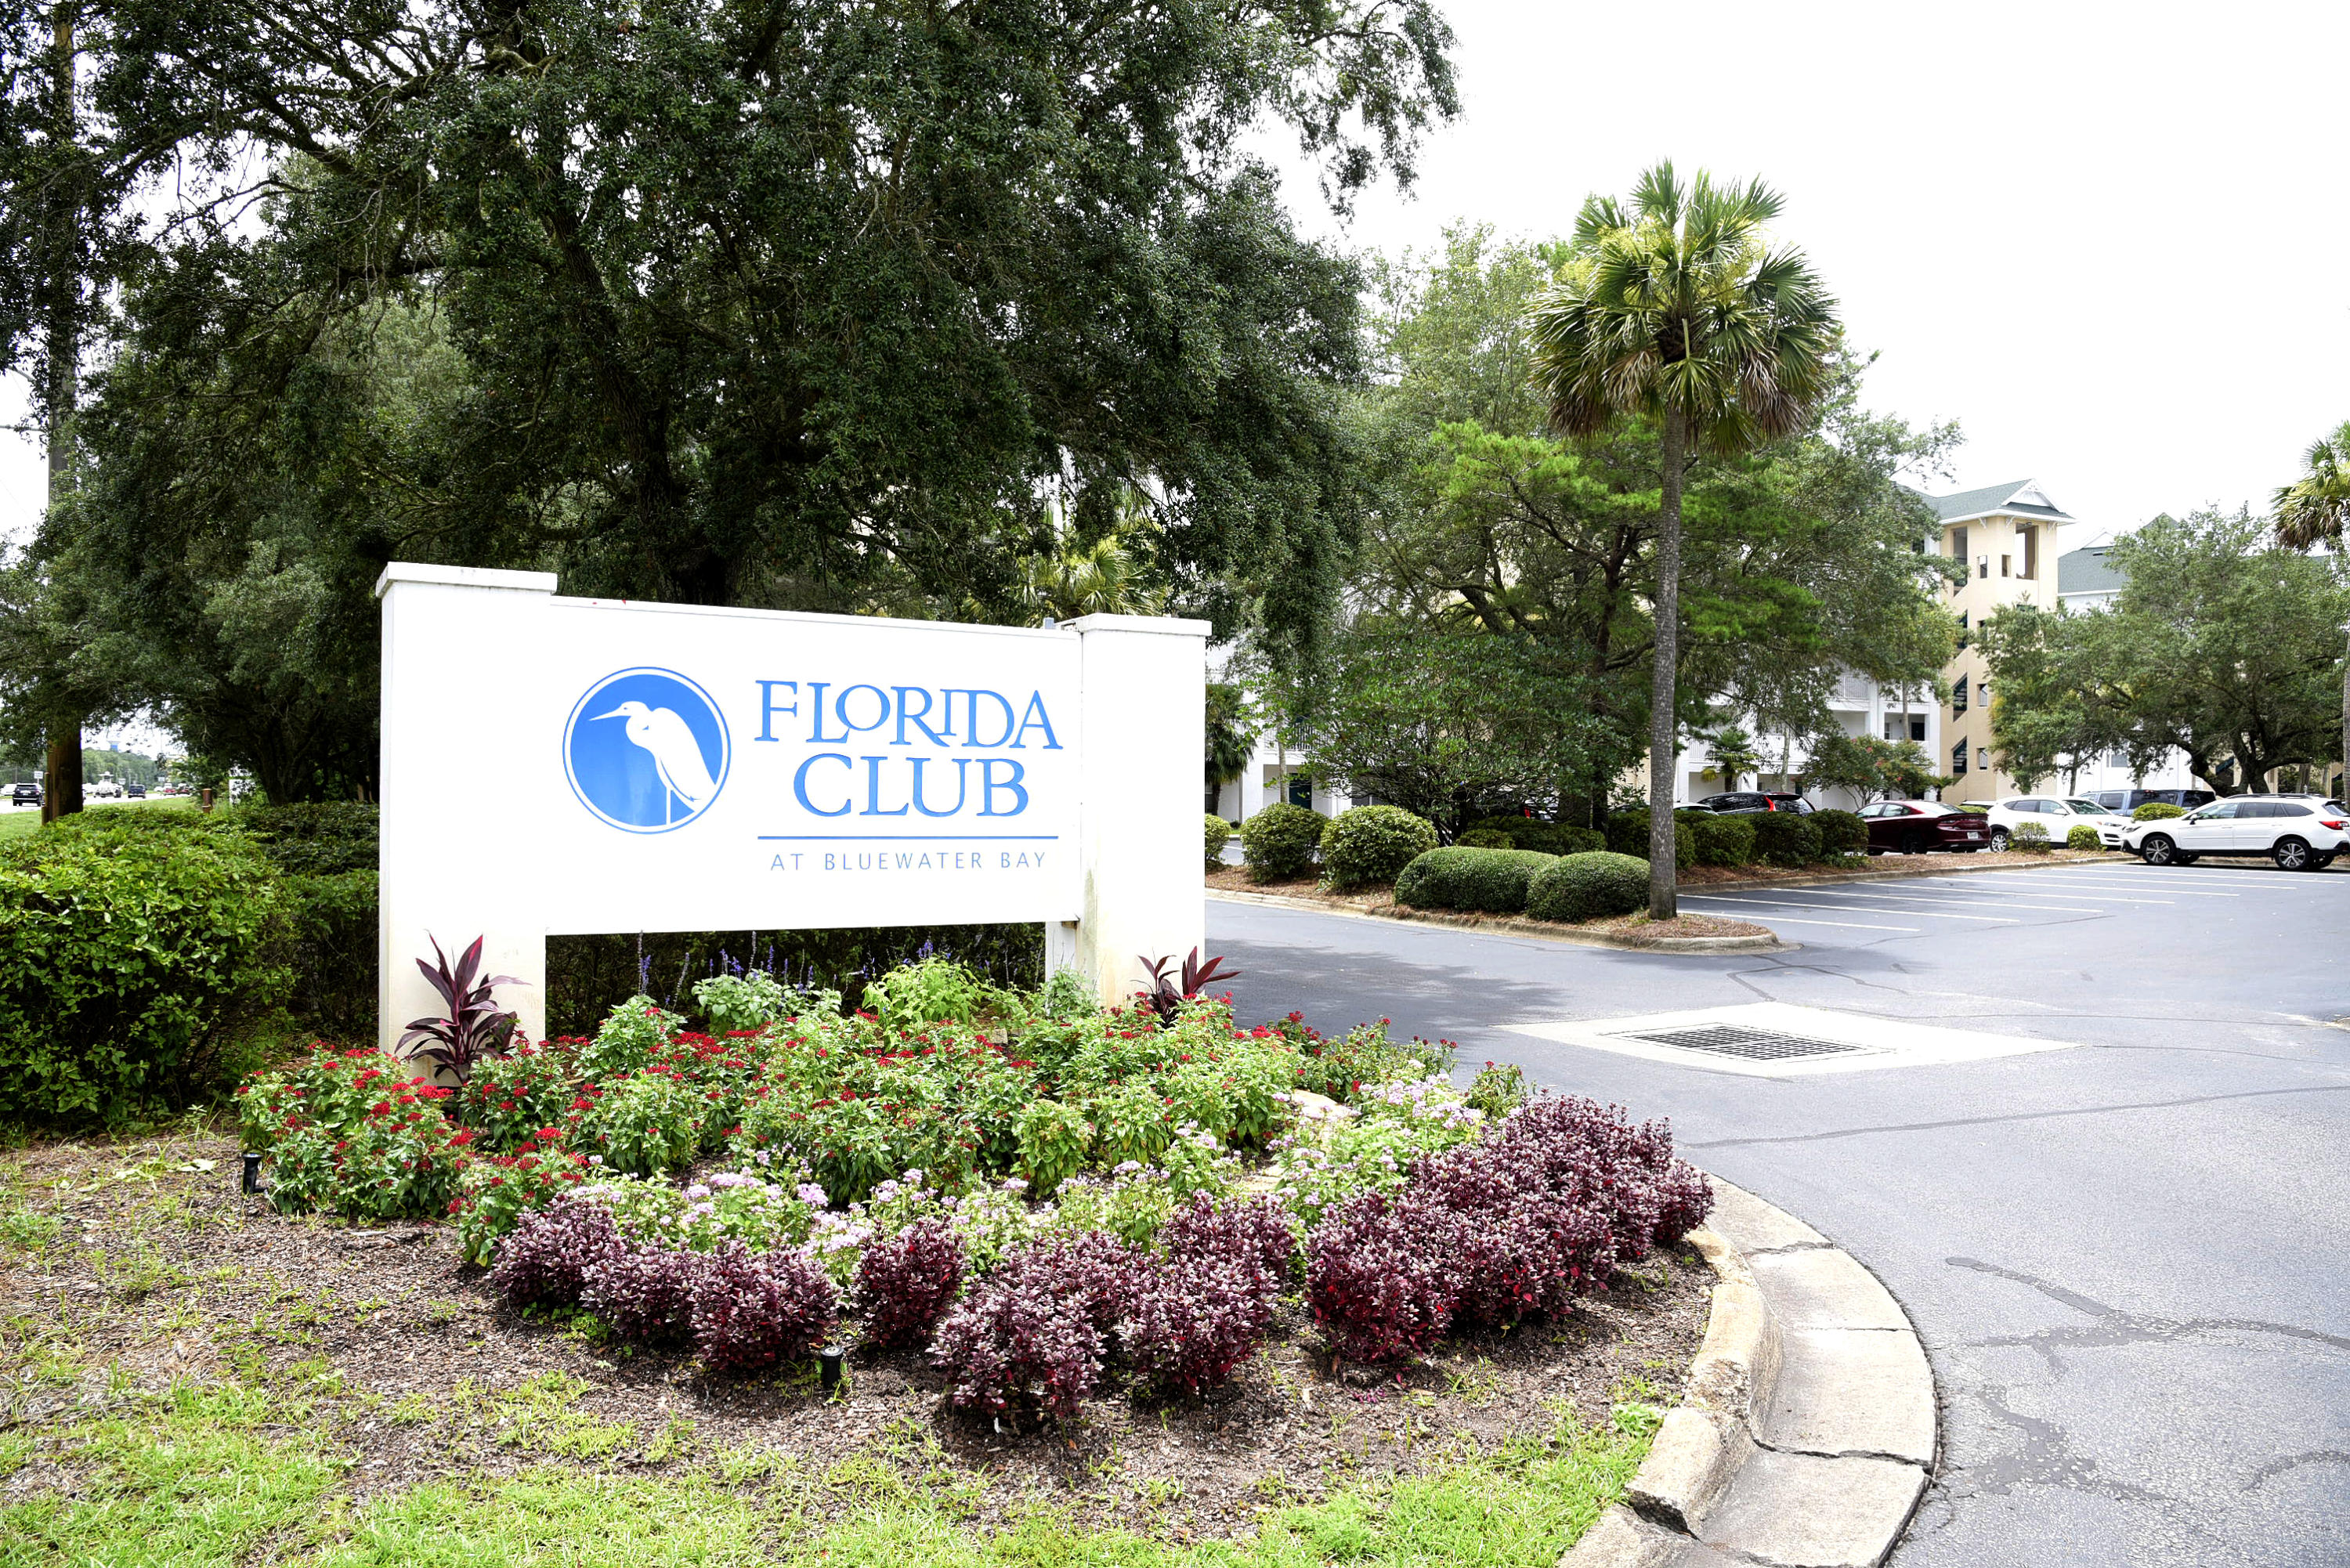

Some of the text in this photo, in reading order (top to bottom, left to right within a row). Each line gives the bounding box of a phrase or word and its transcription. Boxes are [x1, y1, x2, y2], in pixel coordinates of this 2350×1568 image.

[754, 679, 1064, 750] FLORIDA
[794, 753, 1029, 818] CLUB
[771, 851, 1047, 870] AT BLUEWATER BAY
